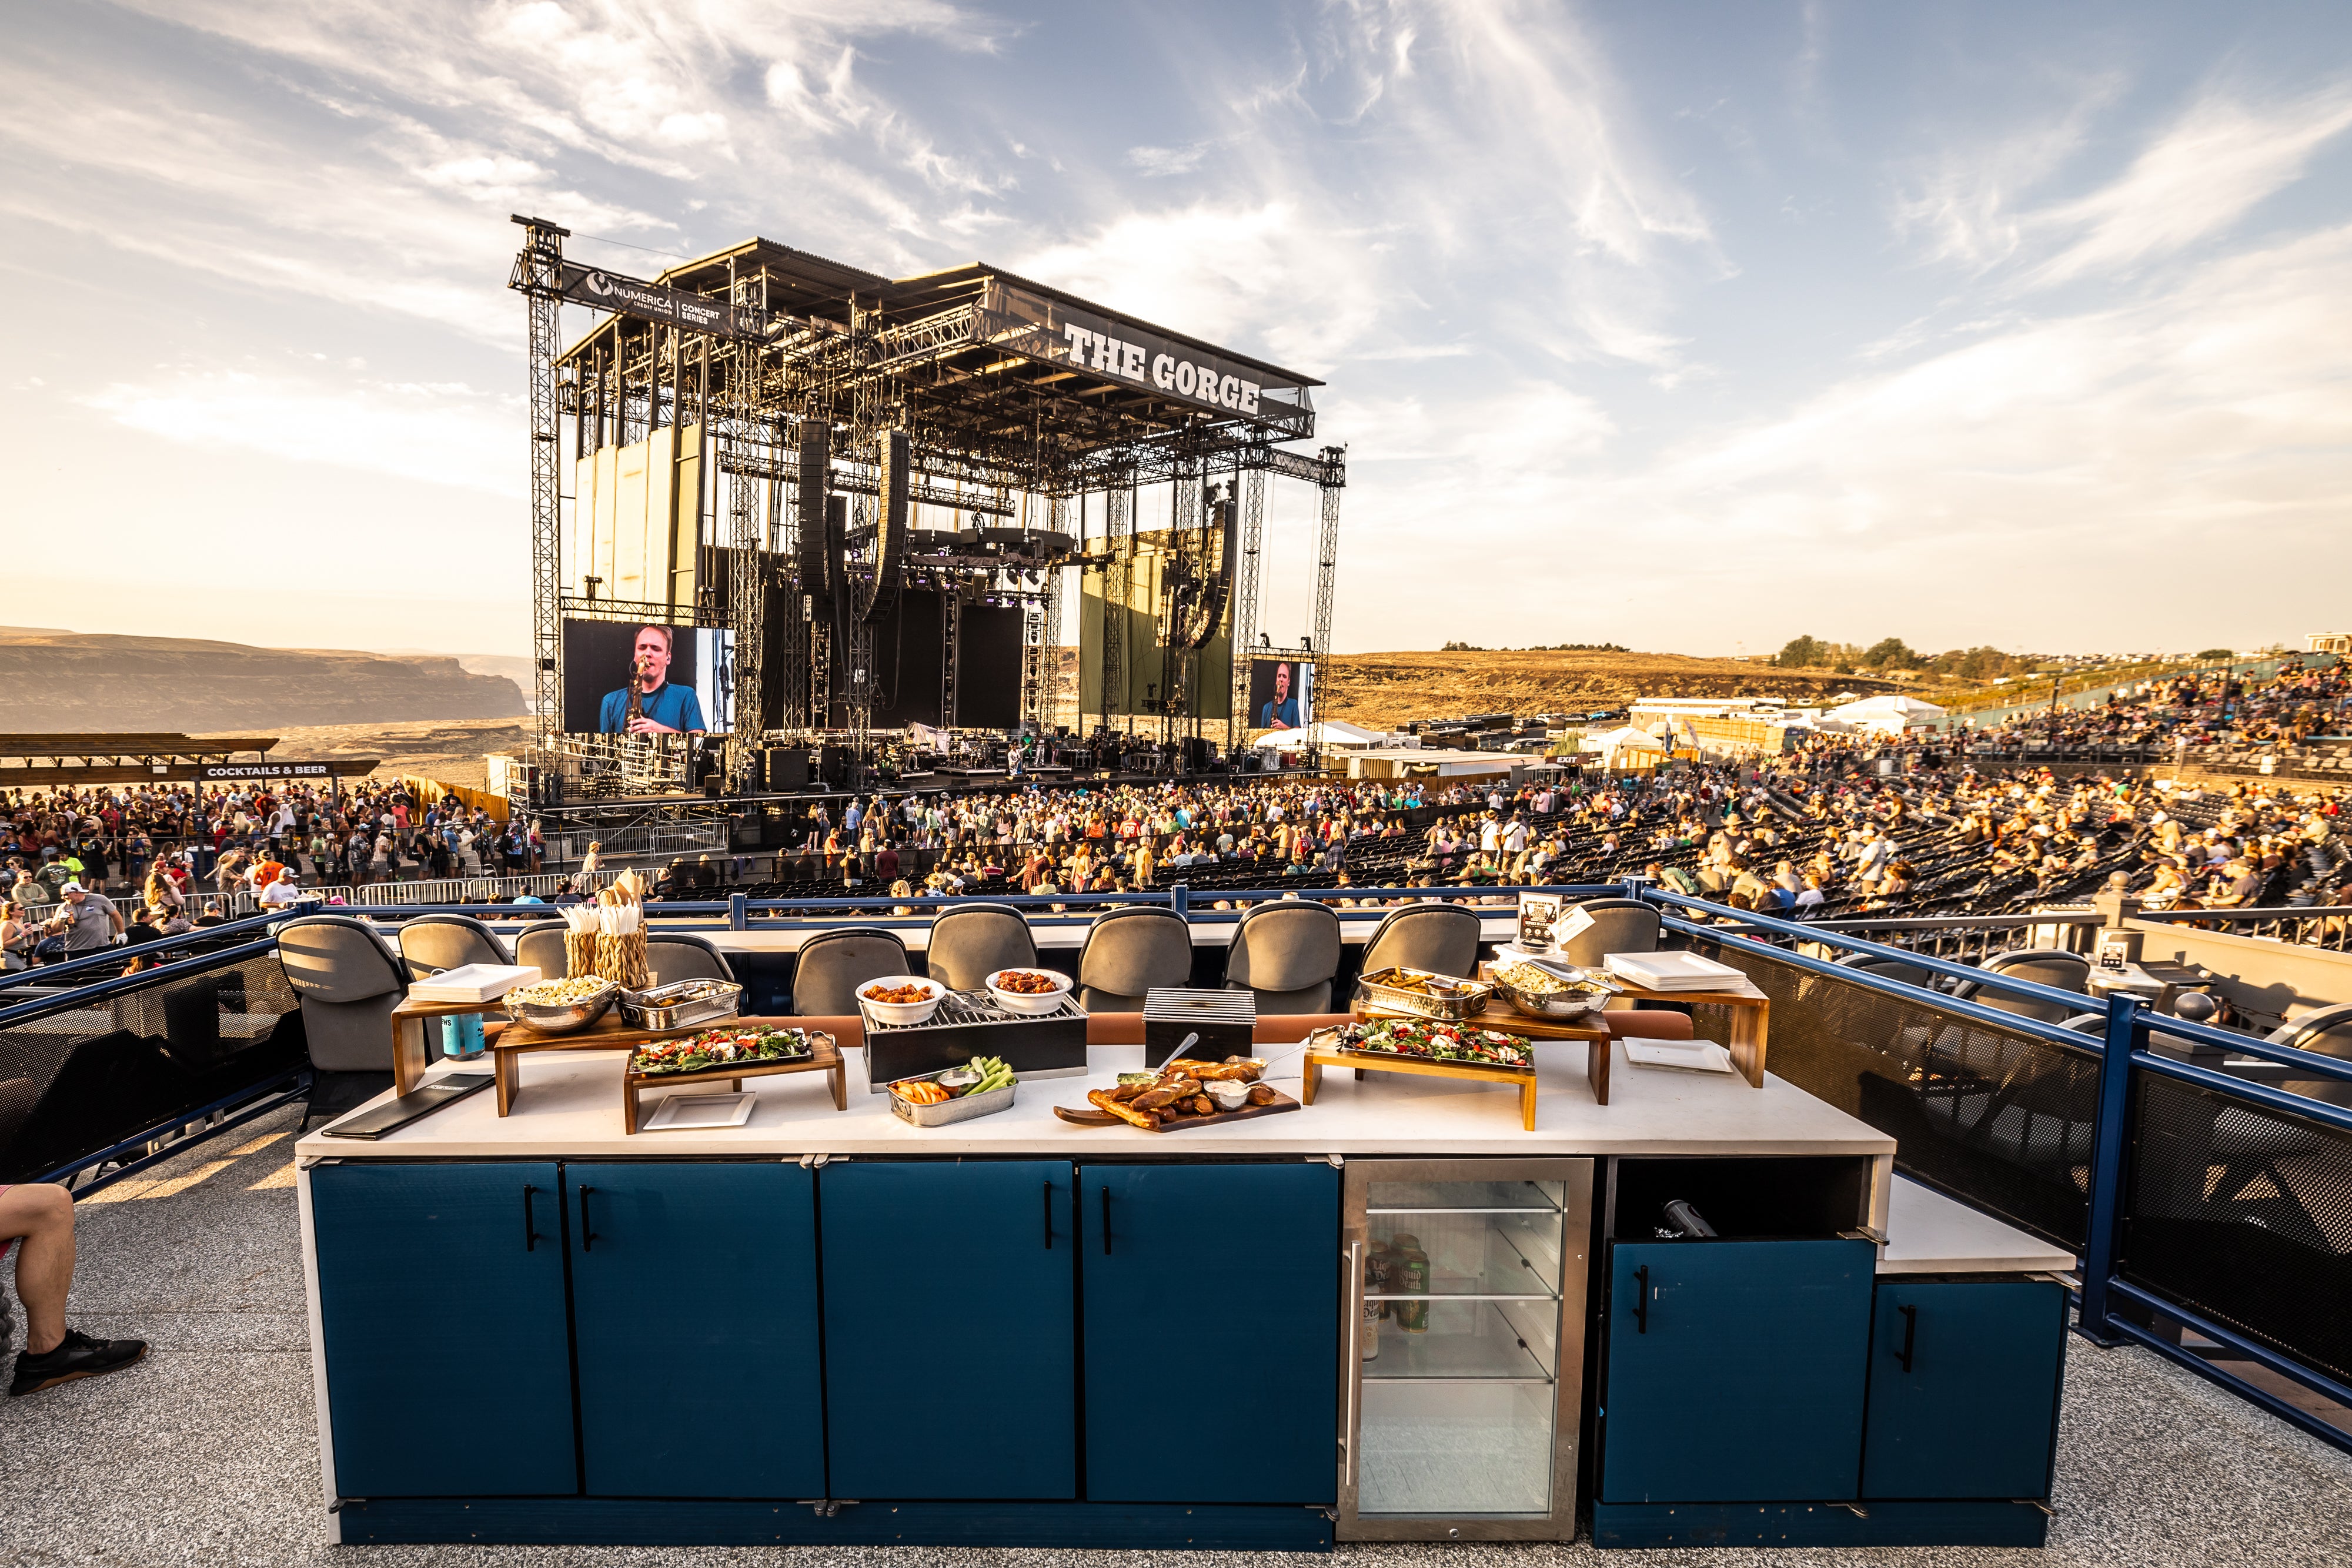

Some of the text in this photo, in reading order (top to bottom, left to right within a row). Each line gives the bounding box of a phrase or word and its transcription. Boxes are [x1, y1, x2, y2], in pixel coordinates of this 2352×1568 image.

[614, 286, 672, 309] NUMERICA
[633, 301, 673, 315] CREDIT UNION
[681, 303, 720, 319] CONCERT
[681, 312, 708, 325] SERIES
[1064, 322, 1260, 415] THE GORGE
[207, 765, 326, 777] COCKTAILS & BEER
